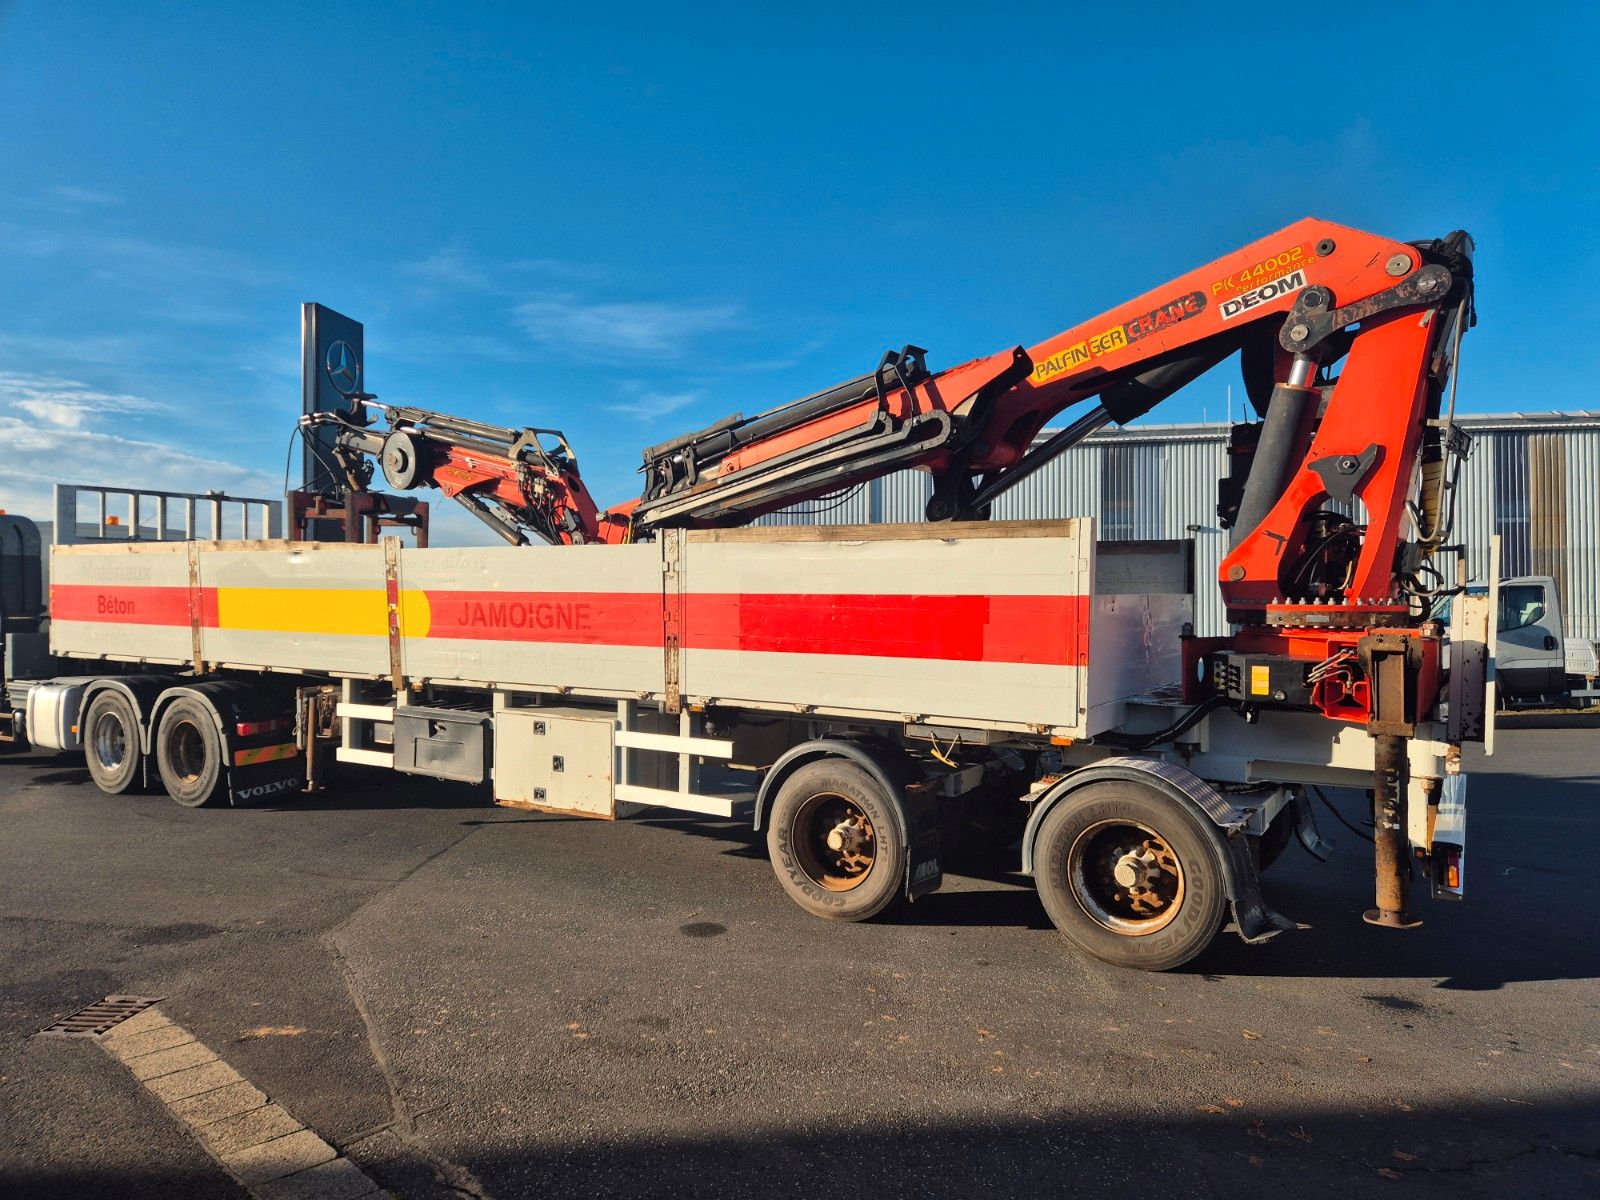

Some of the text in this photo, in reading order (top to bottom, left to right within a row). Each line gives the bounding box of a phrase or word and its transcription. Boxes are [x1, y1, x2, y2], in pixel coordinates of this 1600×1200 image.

[1211, 246, 1303, 297] PK 44002
[1224, 271, 1304, 317] DEOM
[1235, 255, 1316, 294] Performance
[1035, 297, 1203, 379] PALFINGER CRANE
[98, 594, 136, 615] Béton
[458, 602, 592, 631] JAMOIGNE
[236, 777, 298, 799] VOLVO
[778, 827, 848, 908] GOODYEAR
[1121, 859, 1205, 954] GOODYEAR
